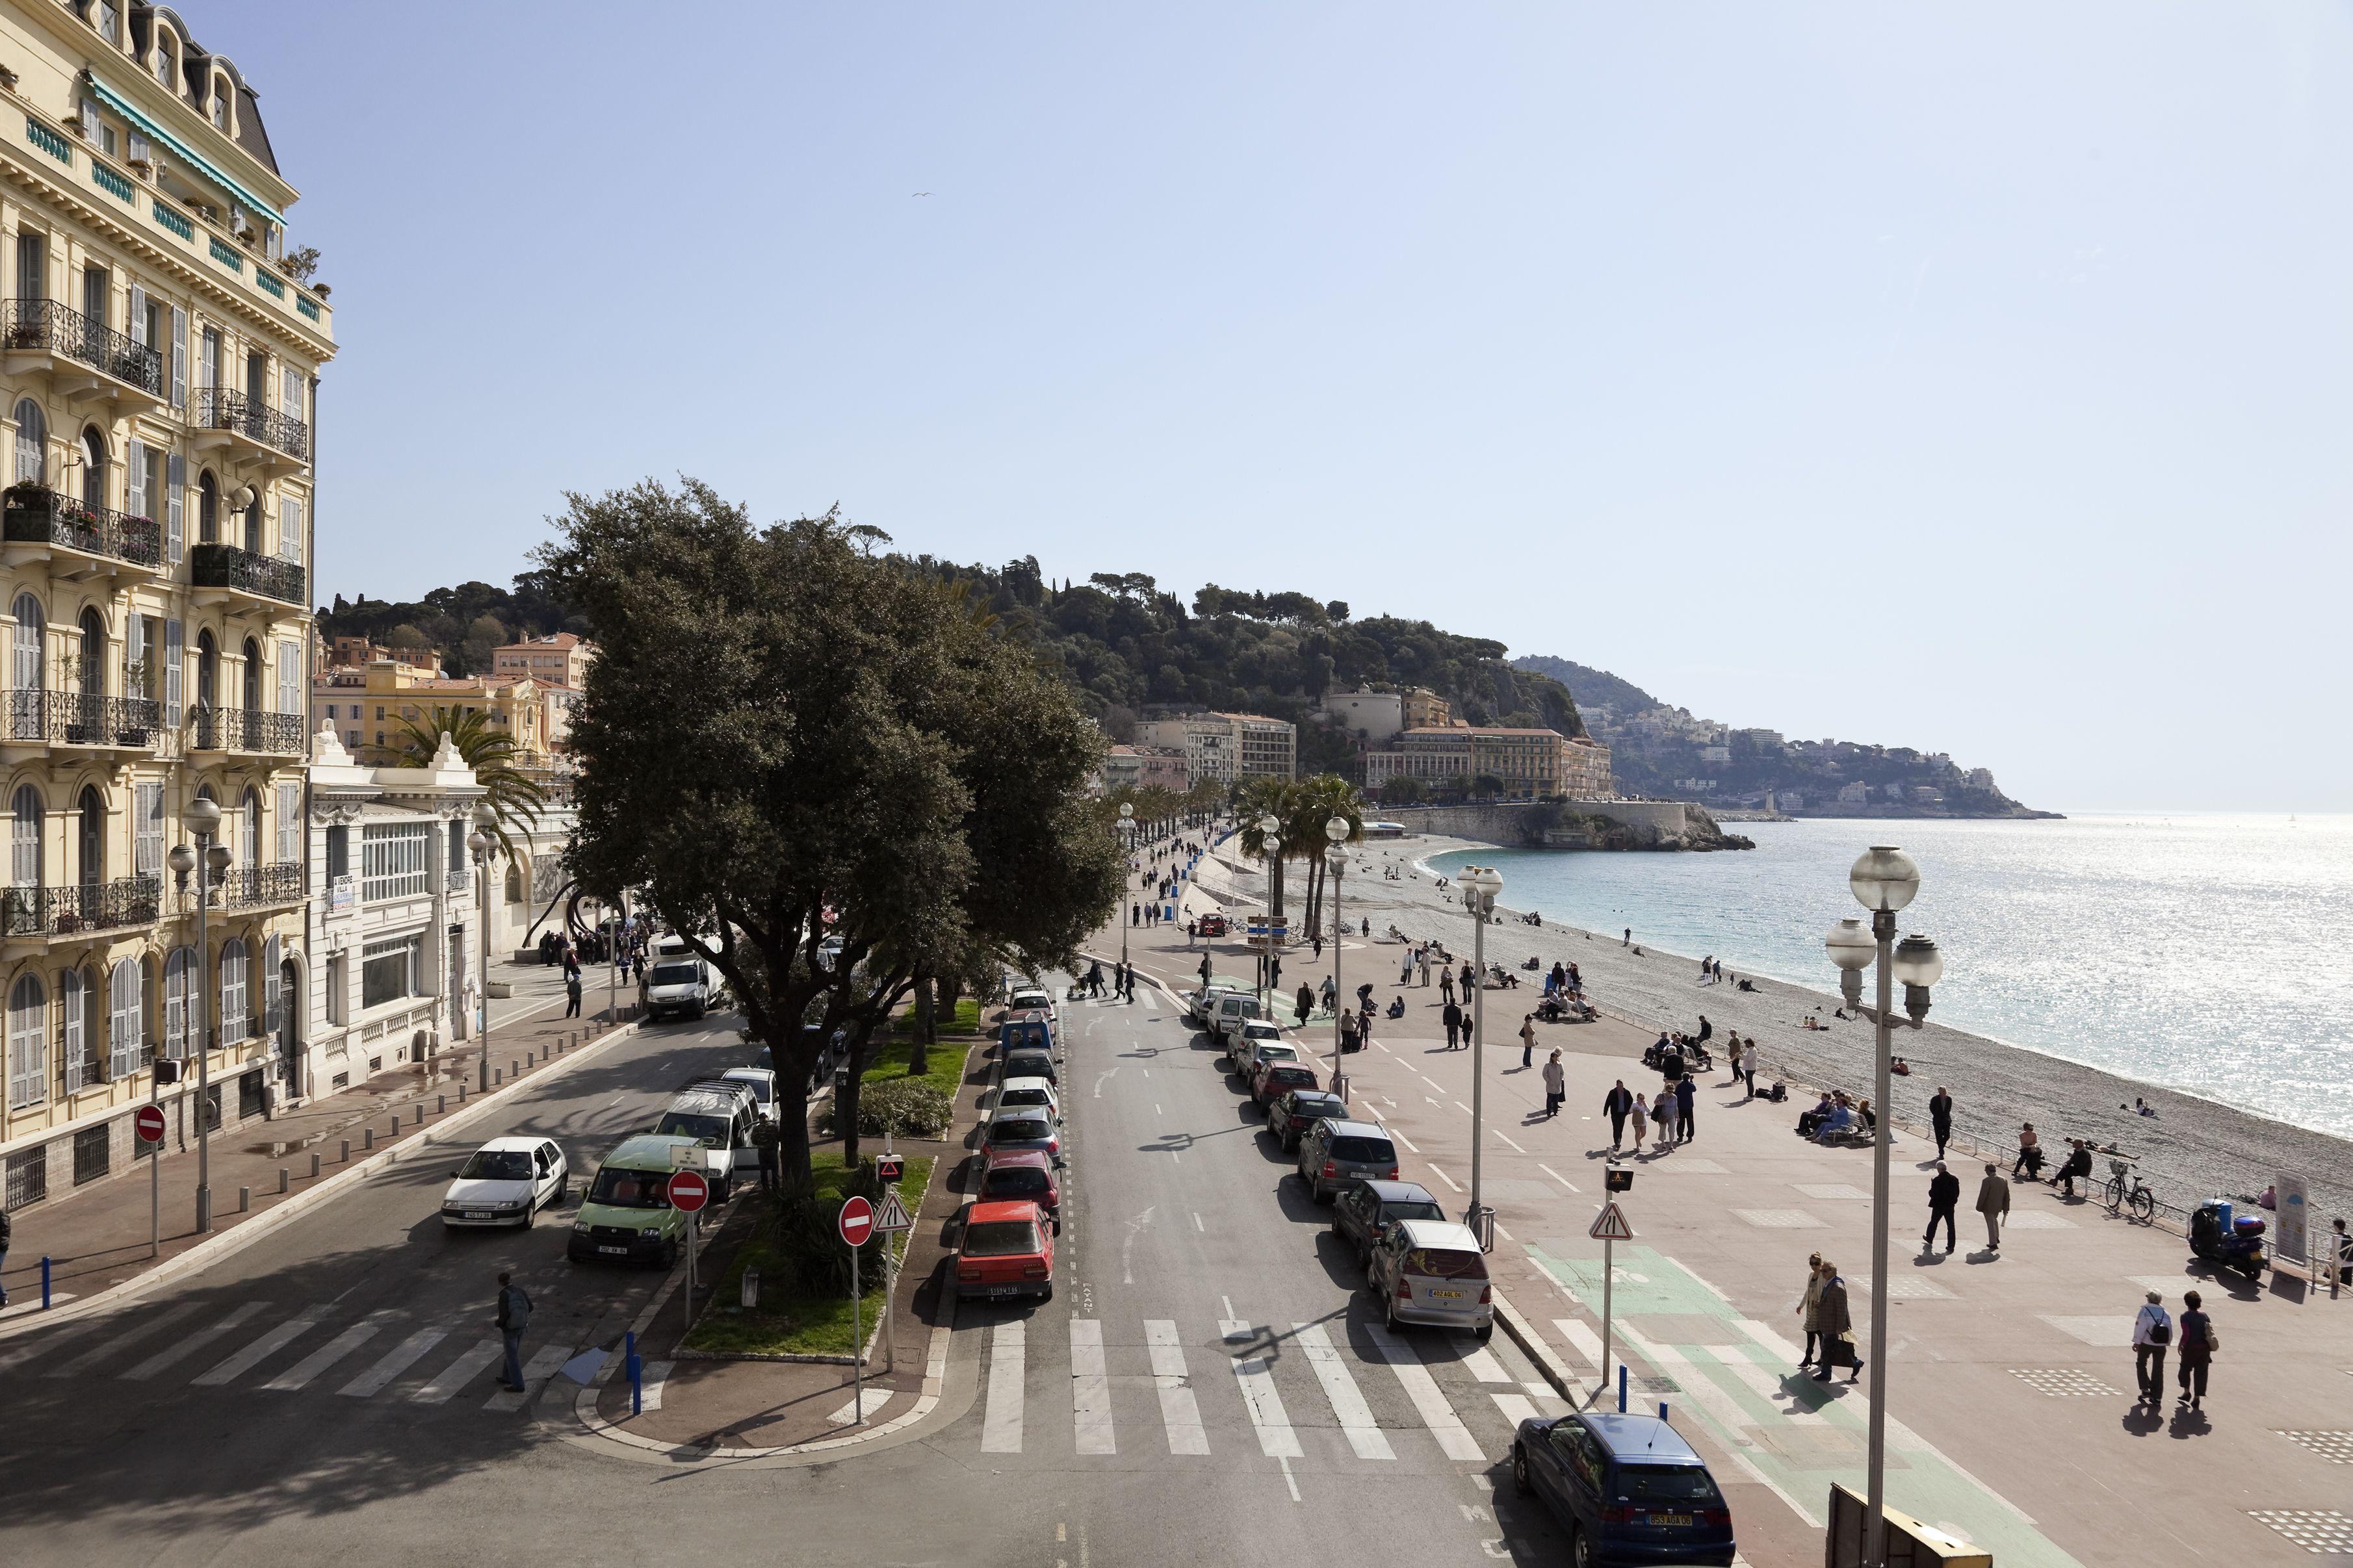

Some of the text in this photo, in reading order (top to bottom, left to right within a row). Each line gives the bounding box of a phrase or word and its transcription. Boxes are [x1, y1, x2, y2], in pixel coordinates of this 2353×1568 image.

[337, 875, 353, 886] VENDRE
[1650, 1515, 1665, 1524] 853
[1666, 1516, 1680, 1524] AGA
[1681, 1516, 1691, 1524] 06
